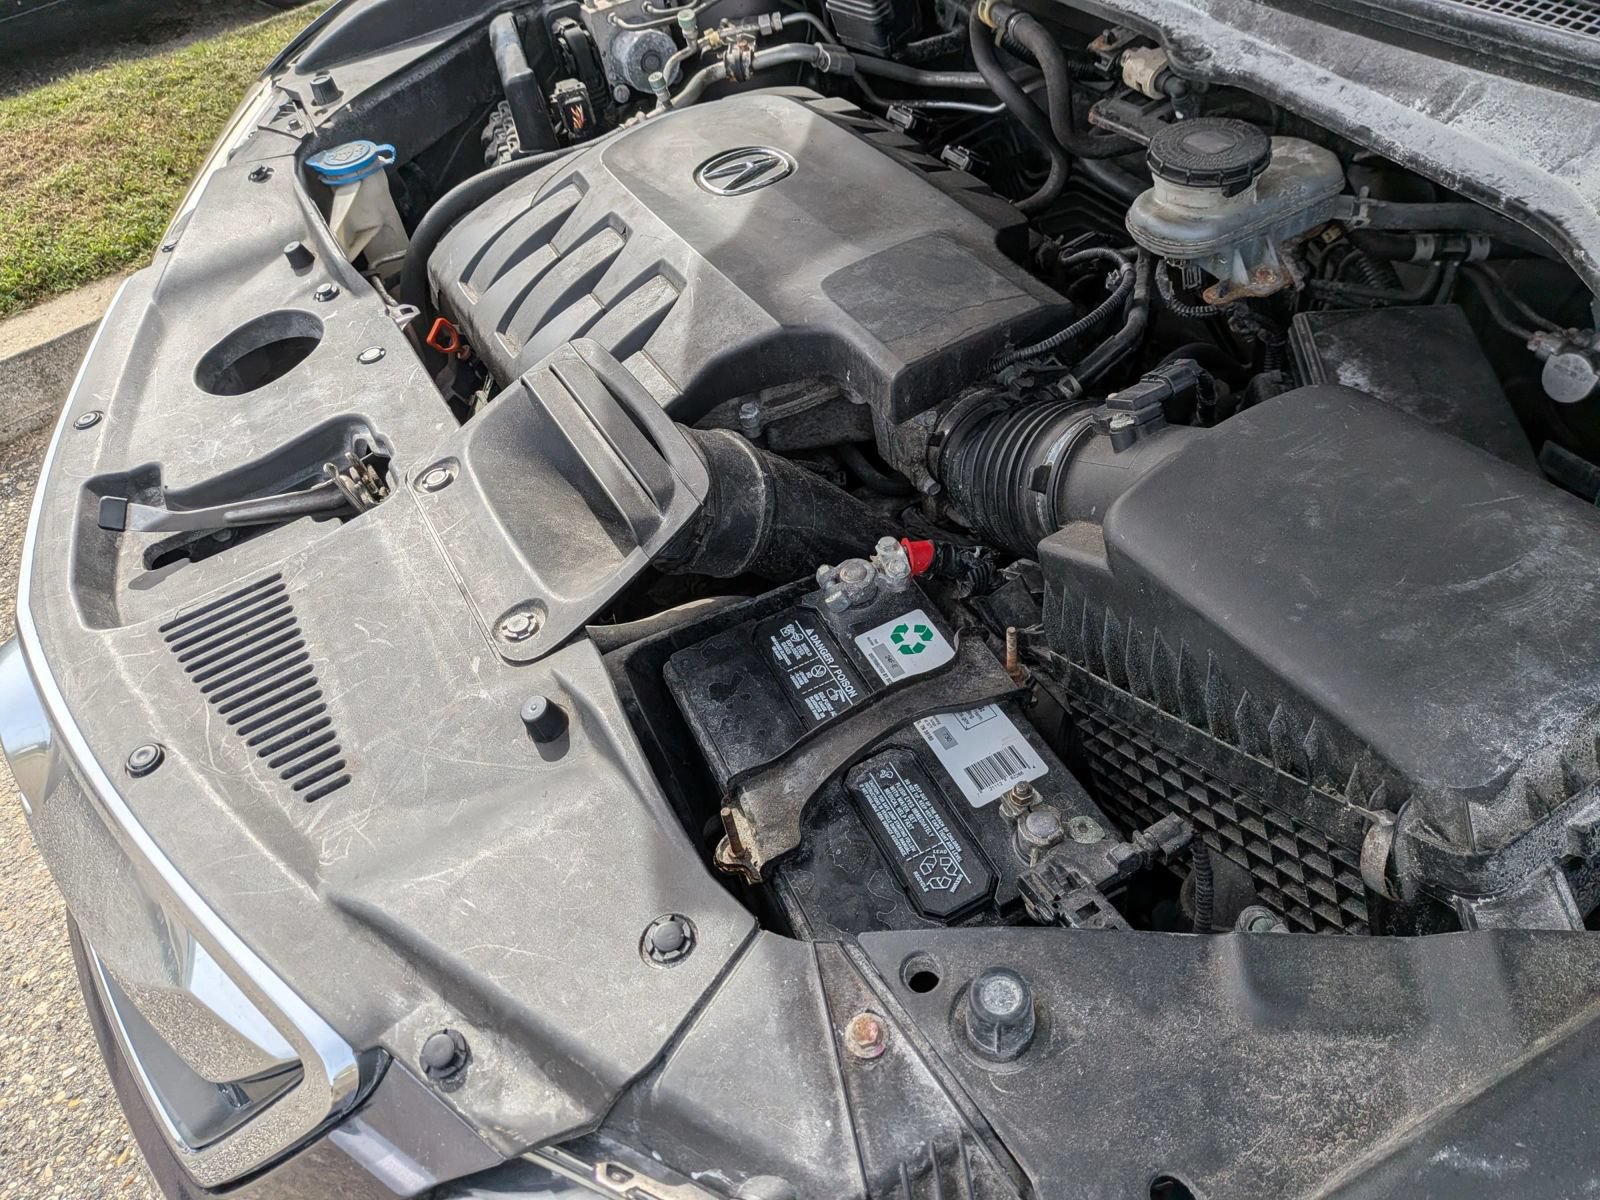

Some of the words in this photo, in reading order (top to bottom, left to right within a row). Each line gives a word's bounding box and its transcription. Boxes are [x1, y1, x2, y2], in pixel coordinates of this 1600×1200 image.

[809, 633, 835, 664] DANGER
[828, 662, 839, 670] /
[832, 668, 858, 698] POISON
[883, 787, 899, 807] MEDICAL
[895, 806, 907, 819] HELP
[903, 817, 915, 830] FAST
[888, 784, 900, 797] WITH
[907, 813, 917, 824] GET
[894, 782, 907, 797] FLUSH
[903, 796, 915, 808] EYES
[910, 806, 934, 838] IMMEDIATELY
[919, 792, 928, 801] OUT
[928, 806, 937, 814] THE
[933, 813, 945, 827] REACH
[945, 832, 962, 852] CHILDREN
[917, 799, 928, 810] KEEP
[930, 819, 941, 830] CAPS
[937, 828, 949, 841] TIGHT
[945, 840, 955, 850] AND
[951, 849, 963, 863] LEVEL
[911, 870, 929, 892] RECYCLE
